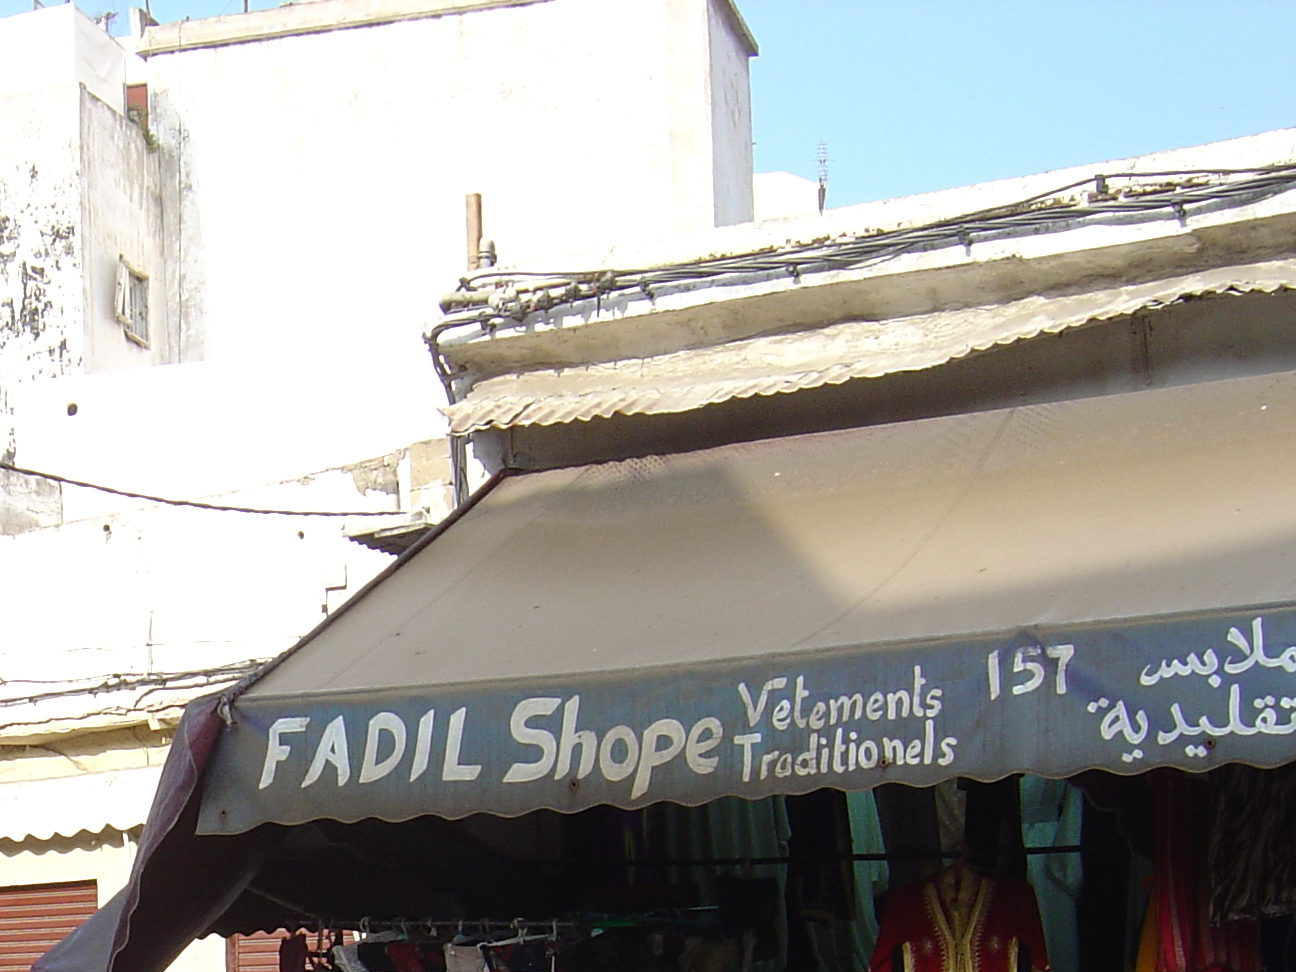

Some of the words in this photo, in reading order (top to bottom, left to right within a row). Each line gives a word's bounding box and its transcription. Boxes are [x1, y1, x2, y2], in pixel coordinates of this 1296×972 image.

[987, 643, 1075, 701] 157
[258, 706, 483, 790] FADIL
[502, 694, 724, 800] Shope
[732, 719, 958, 783] Traditionels
